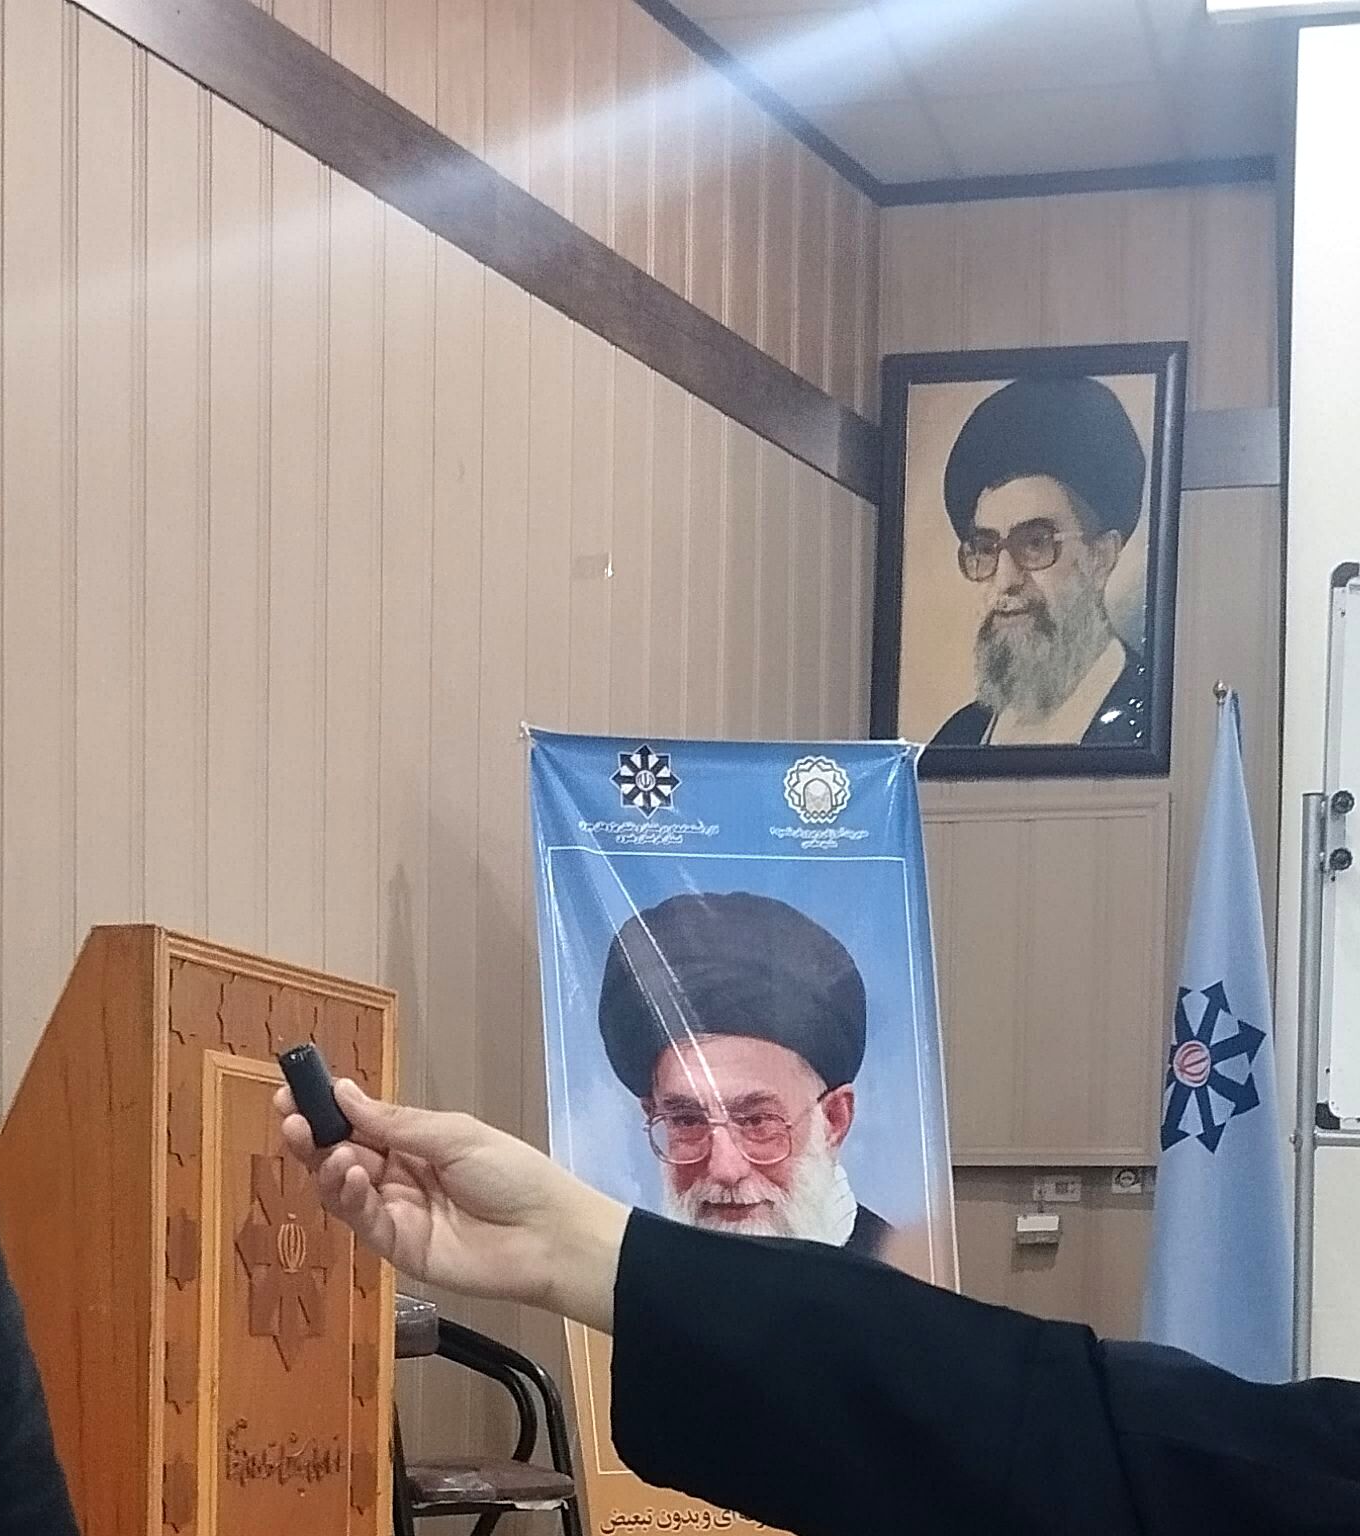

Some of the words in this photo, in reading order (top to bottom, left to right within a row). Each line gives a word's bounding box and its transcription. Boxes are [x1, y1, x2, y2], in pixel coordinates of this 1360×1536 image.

[600, 1508, 654, 1535] تبعیض
[656, 1509, 699, 1531] بدون
[701, 1510, 712, 1530] و
